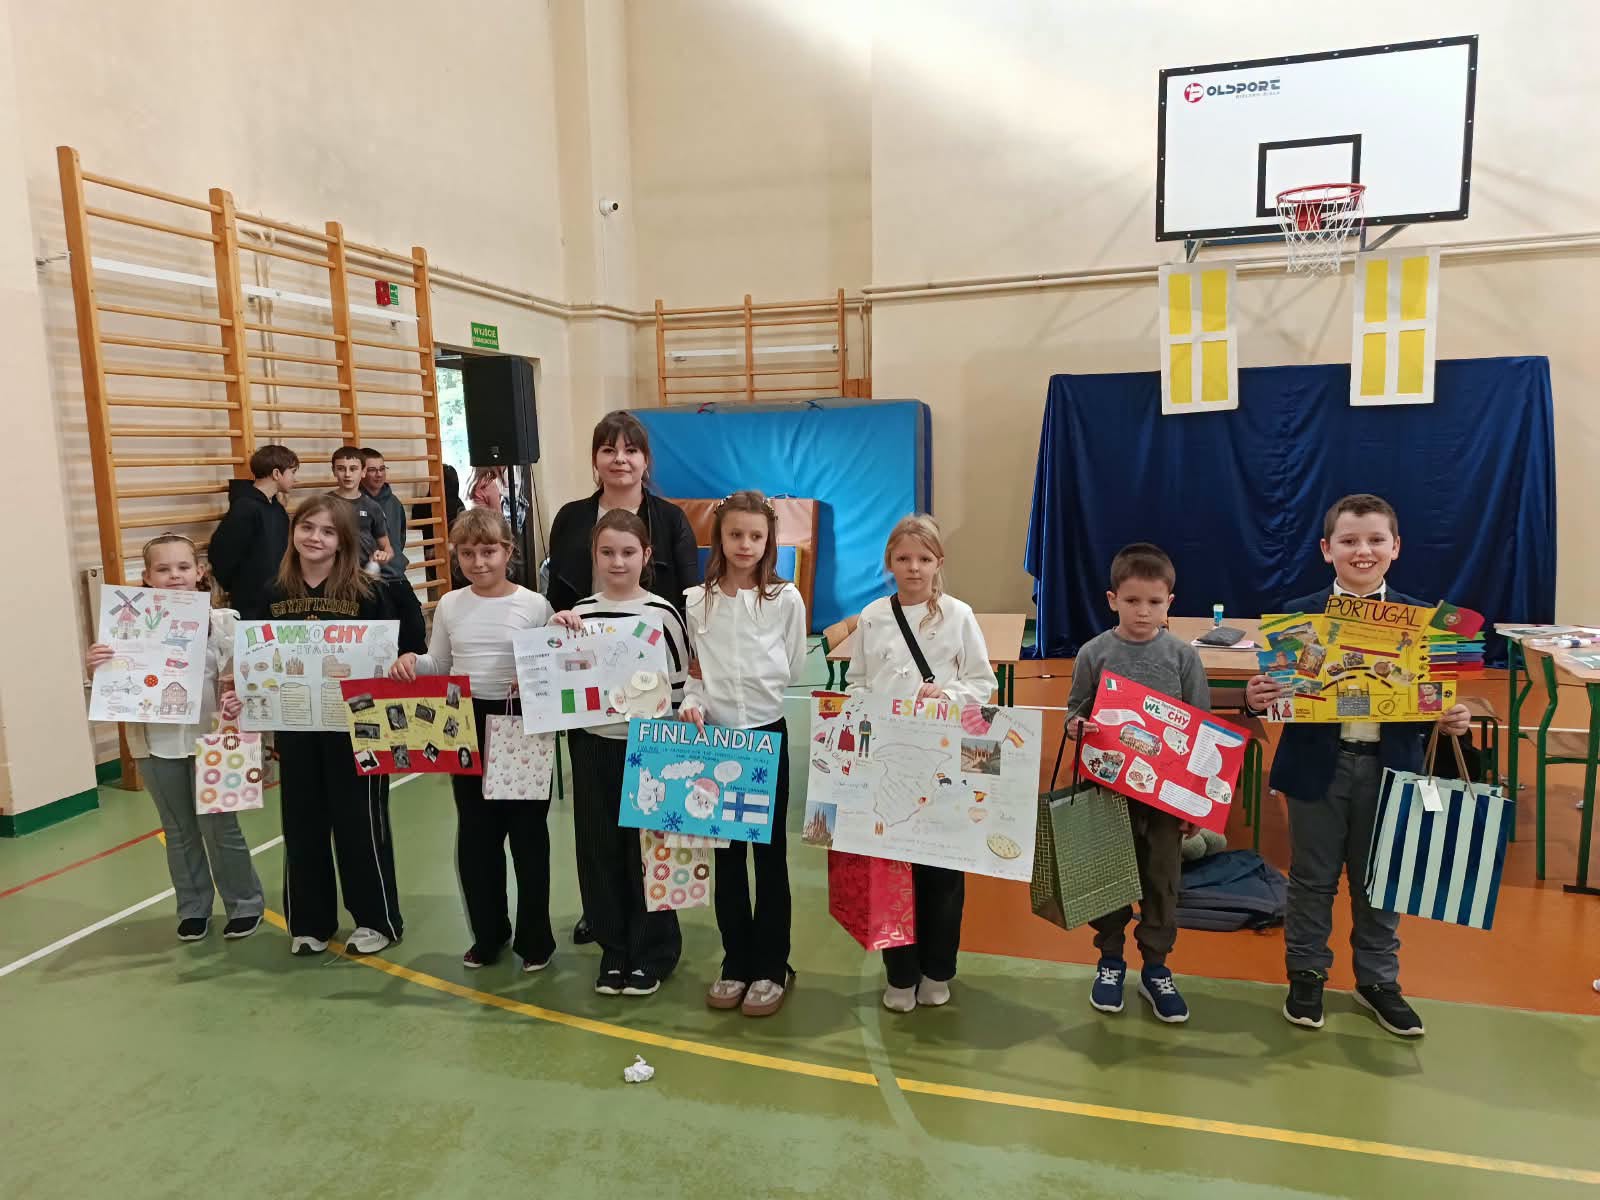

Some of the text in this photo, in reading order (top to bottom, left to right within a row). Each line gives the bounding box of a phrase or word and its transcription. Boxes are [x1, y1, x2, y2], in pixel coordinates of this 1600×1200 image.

[1327, 598, 1421, 627] PORTUGAL
[276, 624, 369, 644] WŁOCHY
[892, 698, 960, 721] ESPAÑA
[1144, 701, 1189, 726] WŁCHY
[638, 721, 775, 755] FINLANDIA
